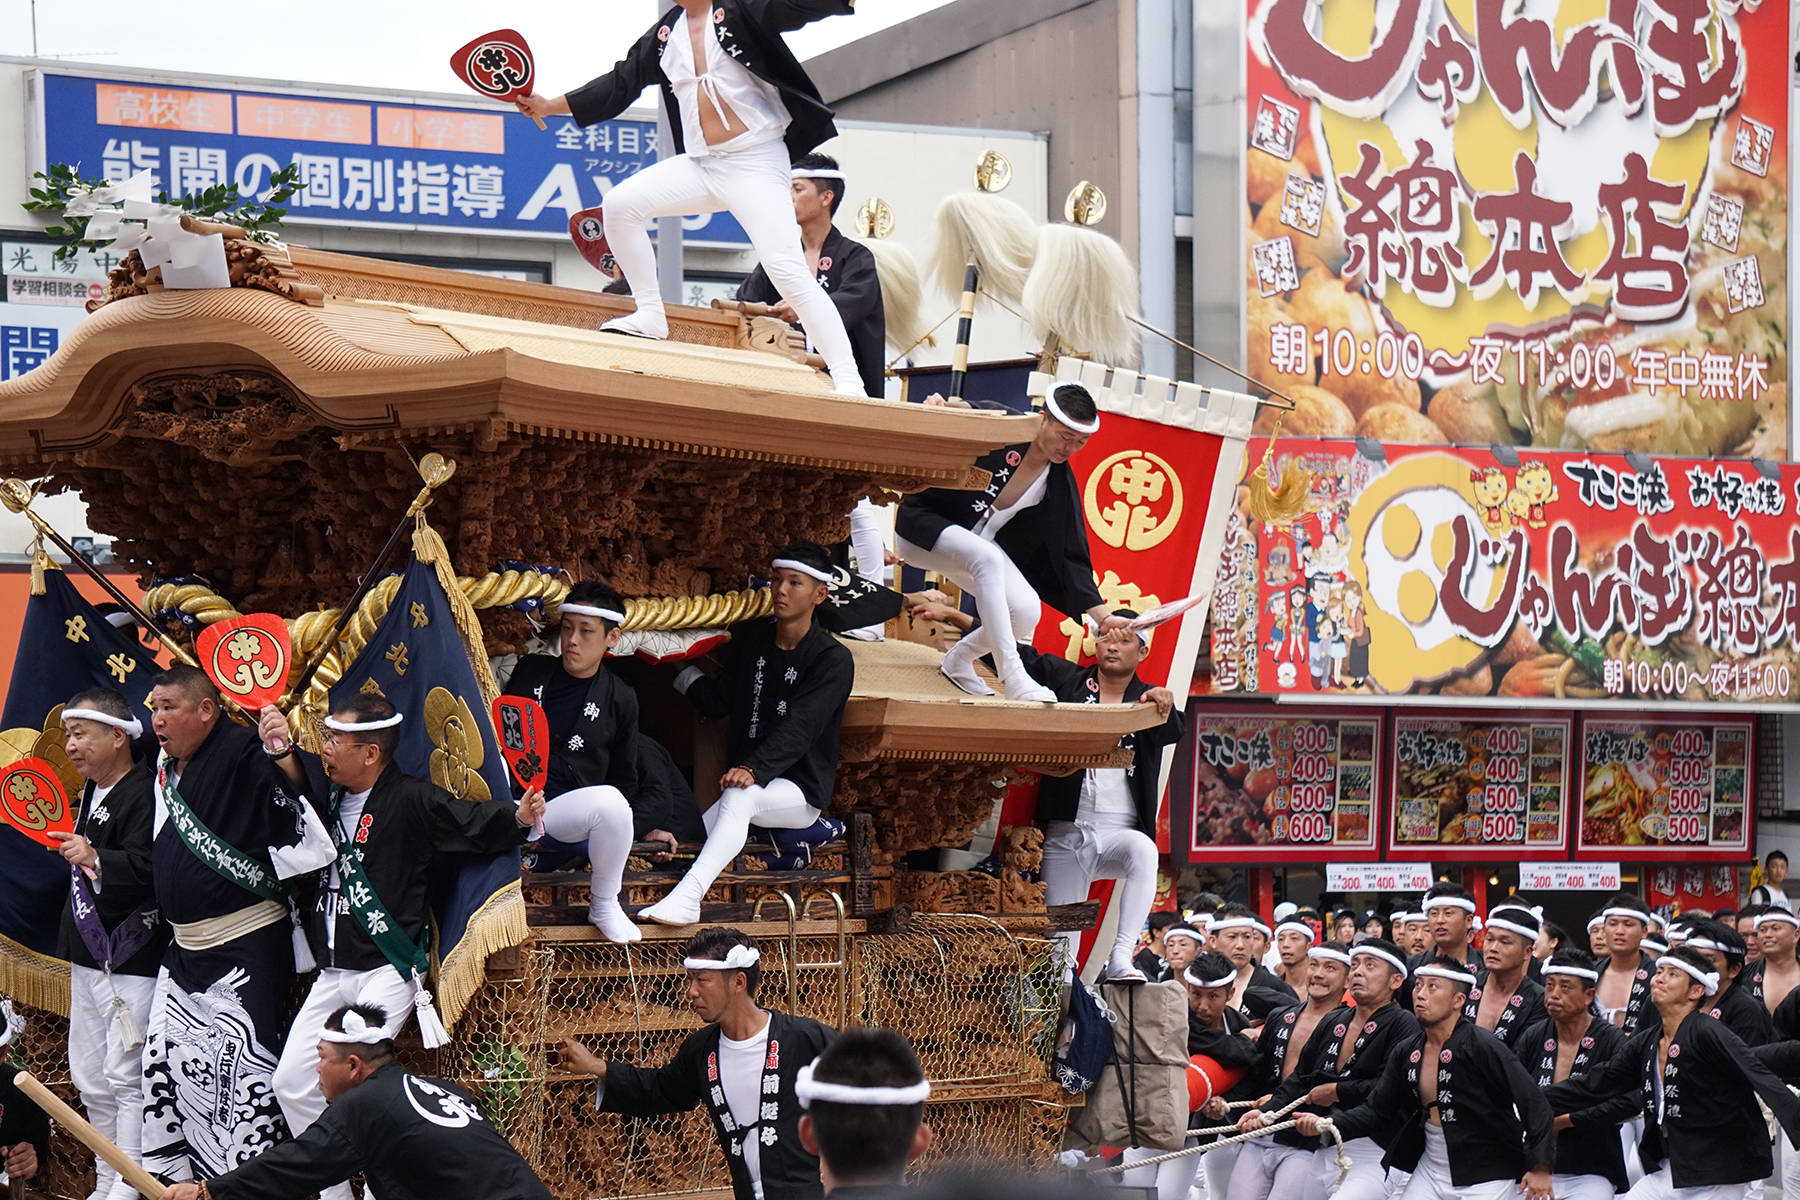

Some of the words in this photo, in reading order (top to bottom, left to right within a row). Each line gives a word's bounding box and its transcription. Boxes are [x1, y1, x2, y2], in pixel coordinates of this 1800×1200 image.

[114, 90, 215, 127] 高校生
[257, 102, 355, 139] 中学生
[392, 114, 489, 147] 小学生
[12, 279, 87, 298] 学習相談会
[1631, 349, 1769, 401] 年中無休
[972, 467, 1009, 513] 大工方
[1565, 461, 1674, 514] たこ焼
[1687, 465, 1784, 518] お好み焼
[827, 580, 878, 608] 大工方
[567, 702, 600, 751] 御祭
[1293, 725, 1336, 752] 300円
[1200, 731, 1275, 771] たこ焼
[1398, 732, 1466, 770] お好み焼
[1486, 728, 1527, 754] 400円
[1586, 733, 1649, 767] 焼そば
[1671, 730, 1710, 757] 400円
[1292, 754, 1335, 782] 400円
[1485, 755, 1526, 782] 400円
[1670, 758, 1709, 785] 500円
[1290, 784, 1334, 812] 500円
[1484, 785, 1525, 812] 500円
[1669, 786, 1708, 813] 500円
[1289, 813, 1332, 841] 600円
[1483, 814, 1523, 841] 500円
[1667, 814, 1707, 841] 500円
[1342, 877, 1361, 890] 300
[1377, 877, 1396, 889] 400
[1411, 877, 1430, 889] 400
[1533, 876, 1552, 888] 300
[1566, 876, 1586, 888] 400
[1600, 876, 1617, 888] 400
[1438, 1069, 1456, 1122] 御祭禮
[1665, 1063, 1682, 1118] 御祭禮
